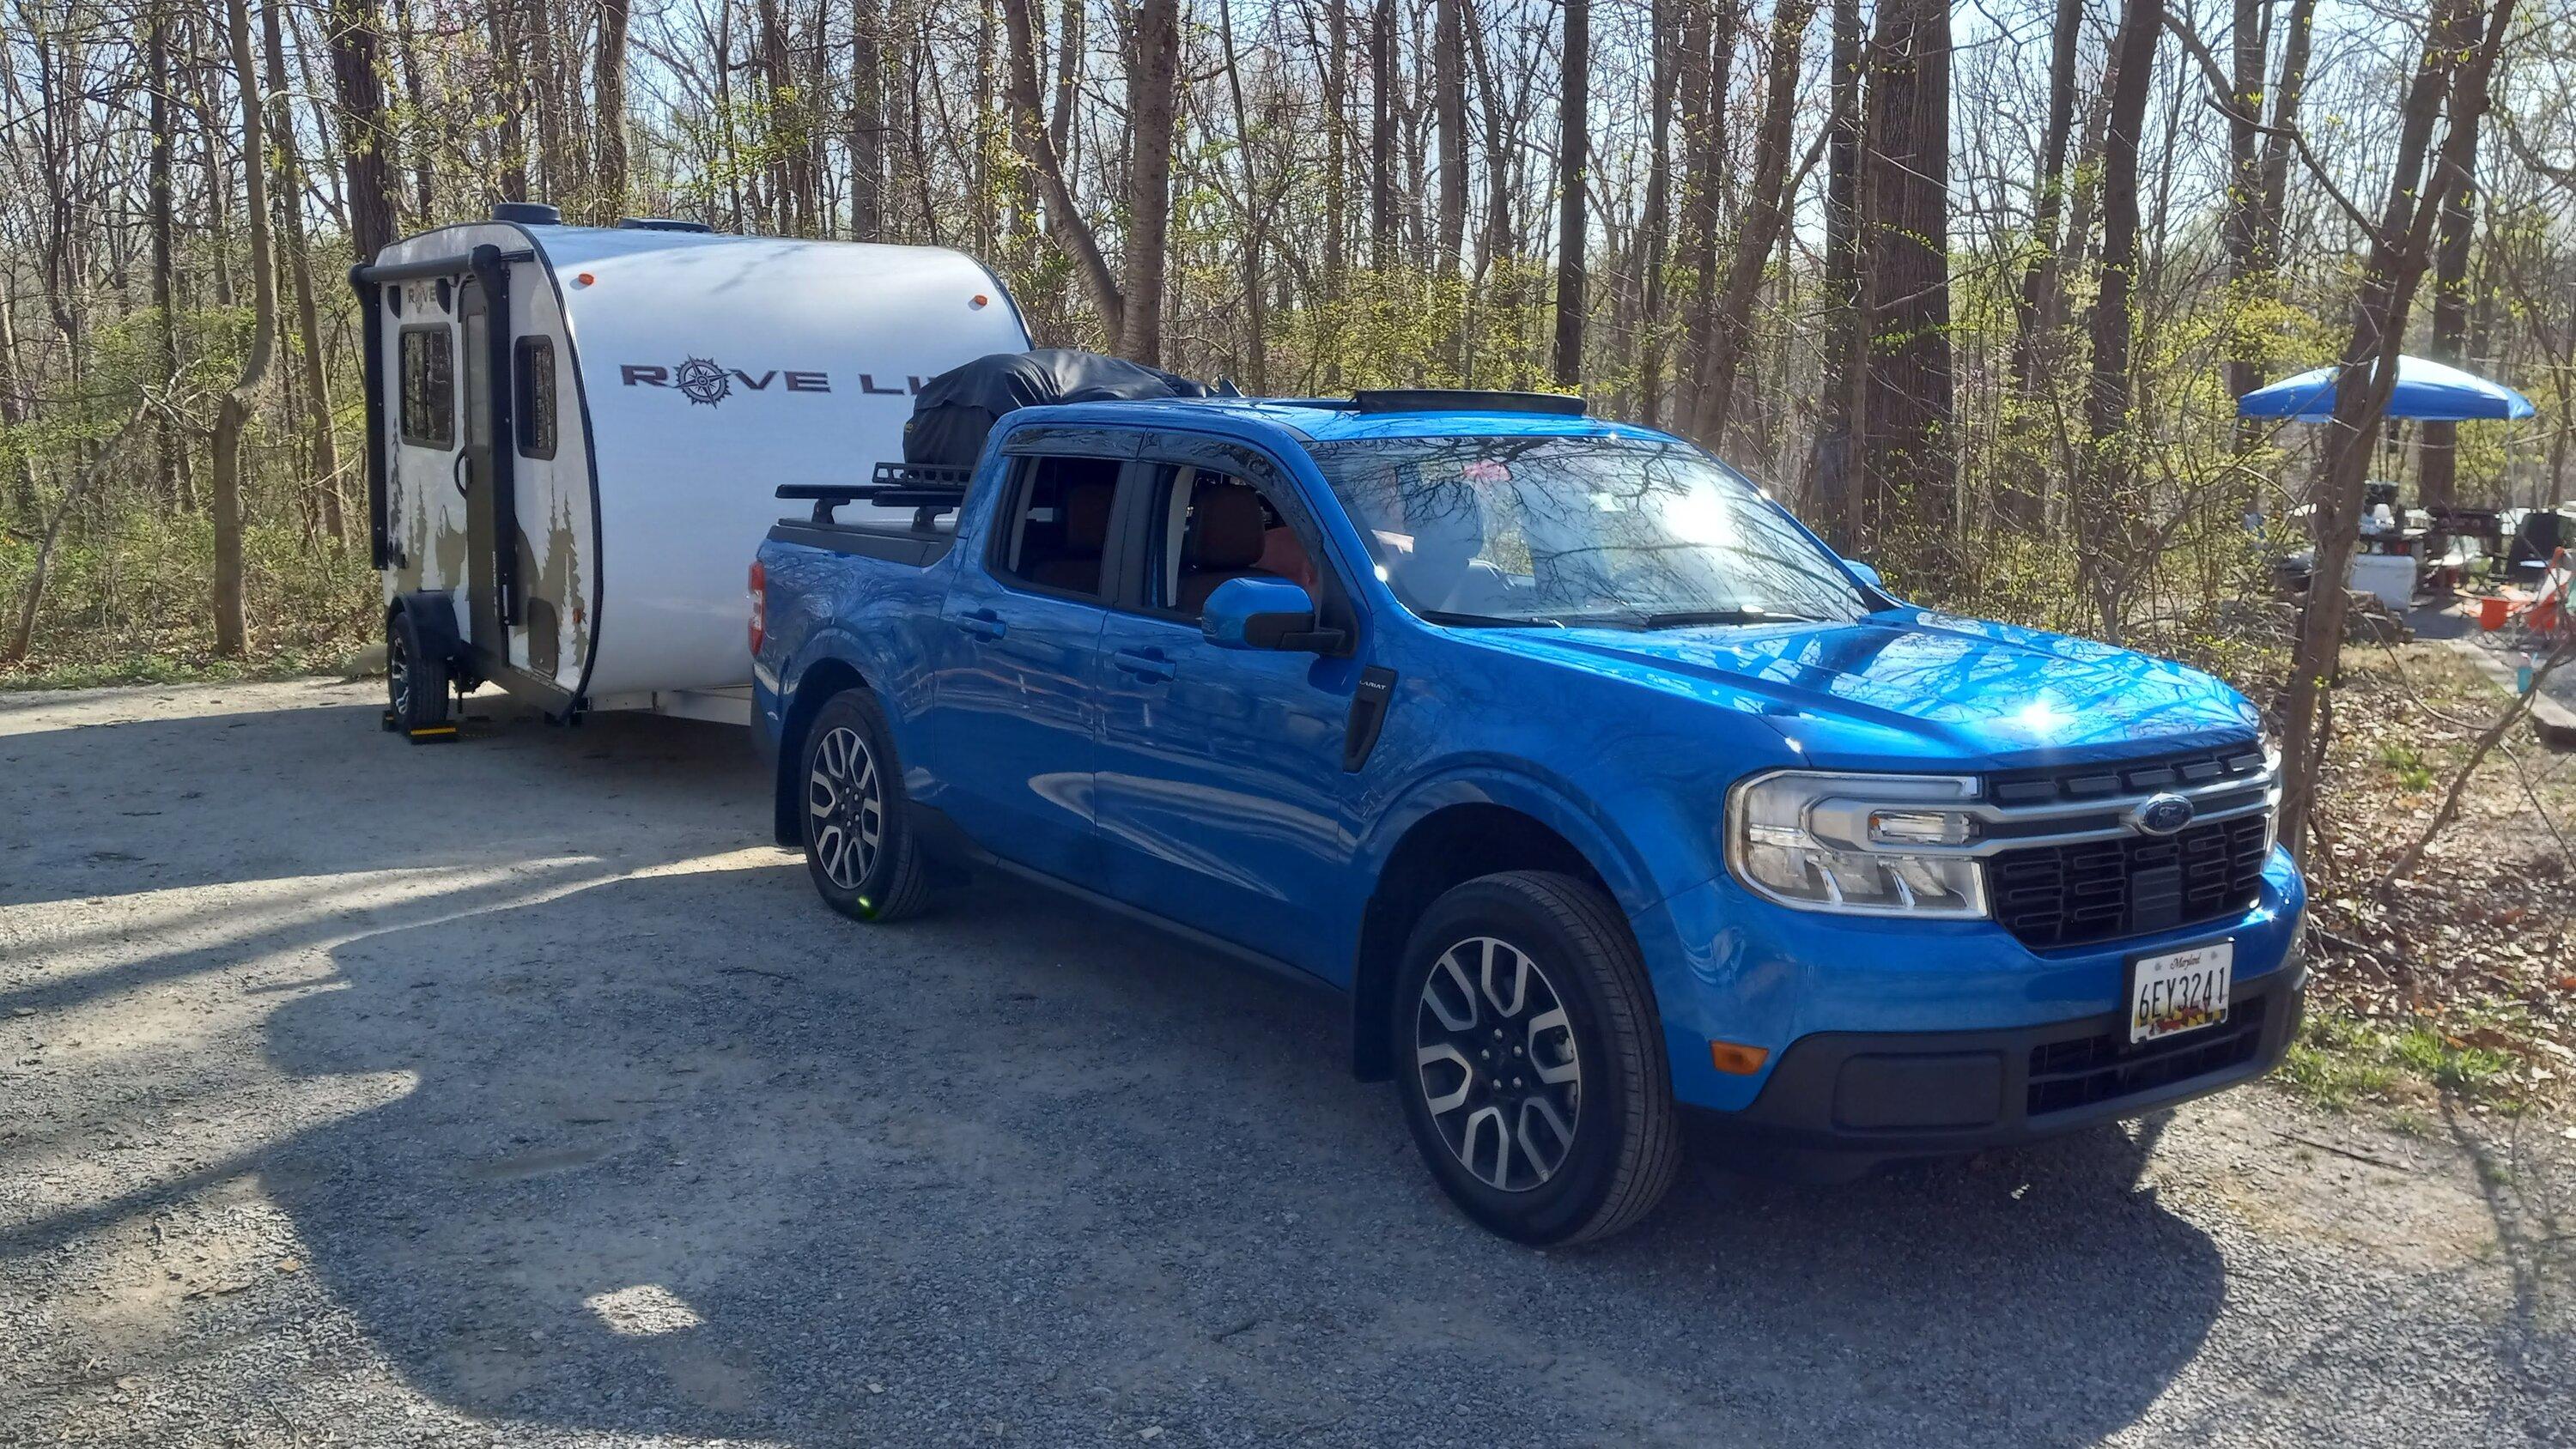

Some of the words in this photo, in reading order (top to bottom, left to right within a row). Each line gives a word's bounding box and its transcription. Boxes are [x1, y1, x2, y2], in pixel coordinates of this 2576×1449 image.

[619, 354, 831, 409] ROVE
[858, 373, 937, 396] LI
[2170, 952, 2202, 971] Maryland
[2139, 967, 2225, 1021] 6EY3241
